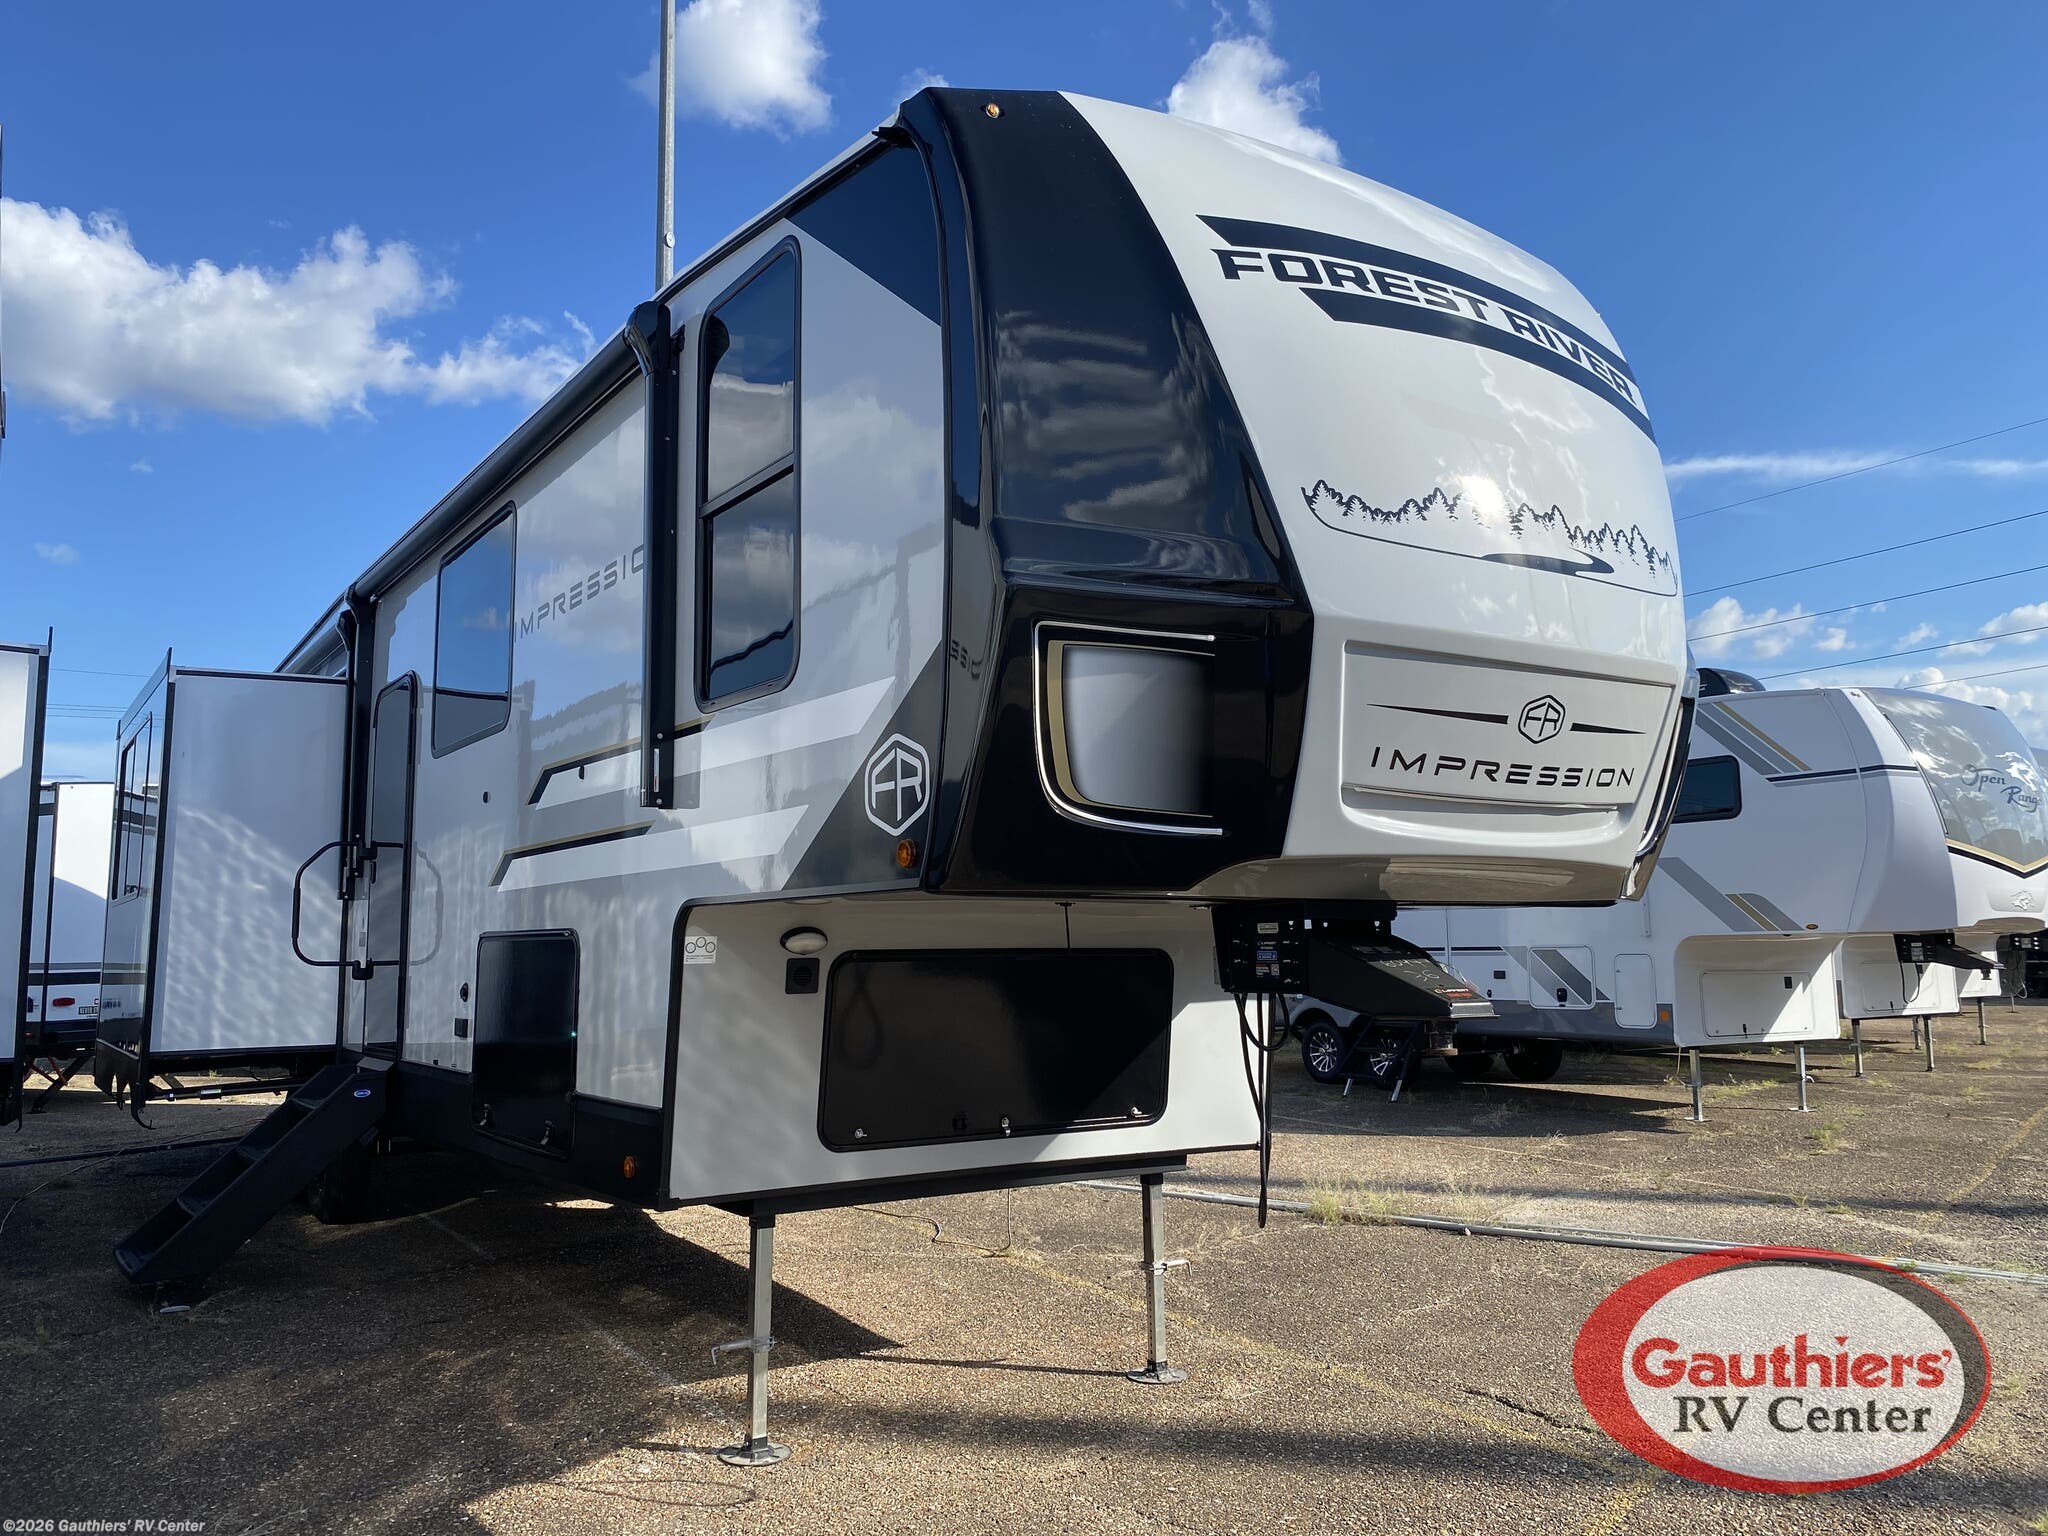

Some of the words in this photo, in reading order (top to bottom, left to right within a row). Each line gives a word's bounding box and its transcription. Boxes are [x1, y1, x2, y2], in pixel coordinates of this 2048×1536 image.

[1211, 247, 1492, 322] FOREST
[1498, 304, 1639, 407] RIVER
[514, 543, 644, 643] IMPRESSIO
[1370, 746, 1635, 788] IMPRESSION
[1961, 764, 2007, 793] Open
